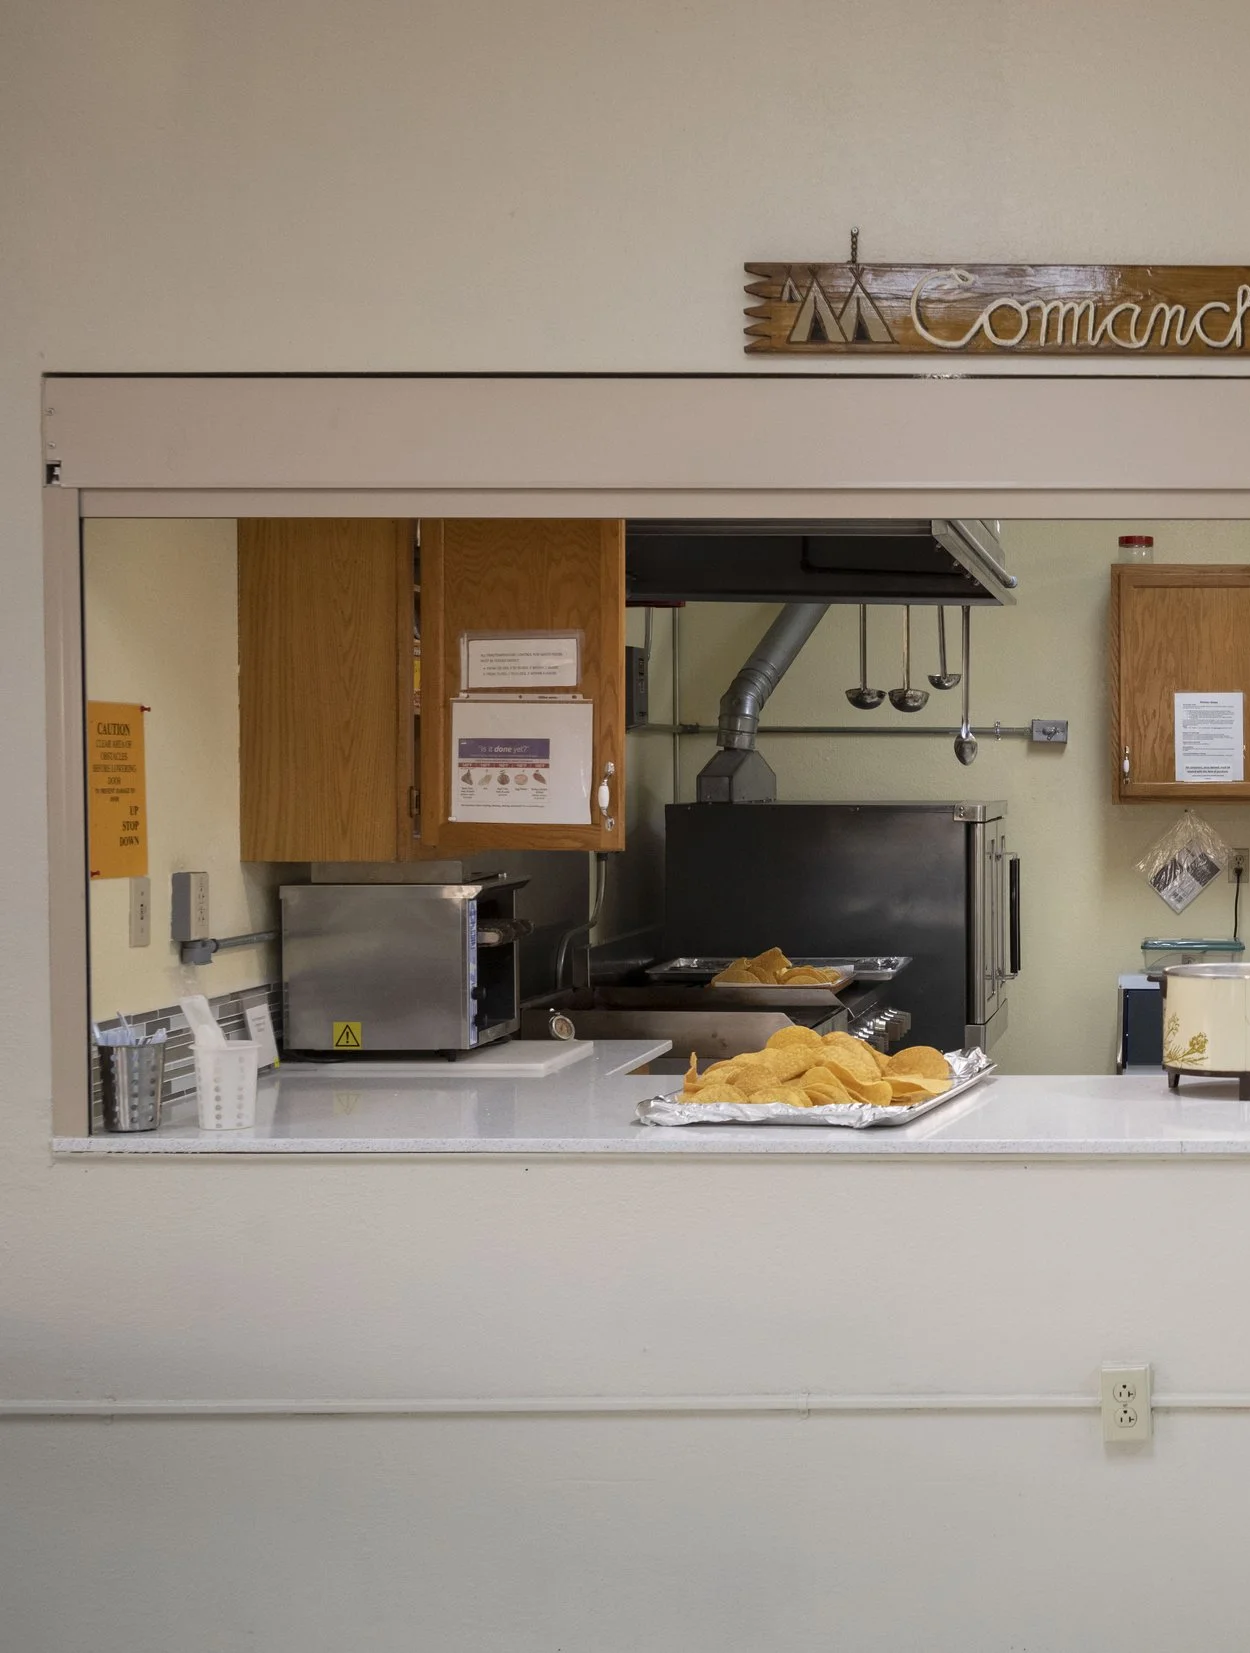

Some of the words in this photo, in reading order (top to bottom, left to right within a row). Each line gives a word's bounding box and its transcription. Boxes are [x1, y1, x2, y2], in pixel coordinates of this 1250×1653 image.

[97, 723, 130, 735] CAUTION
[129, 805, 139, 816] UP
[122, 820, 139, 831] STOP
[119, 836, 139, 846] DOWN
